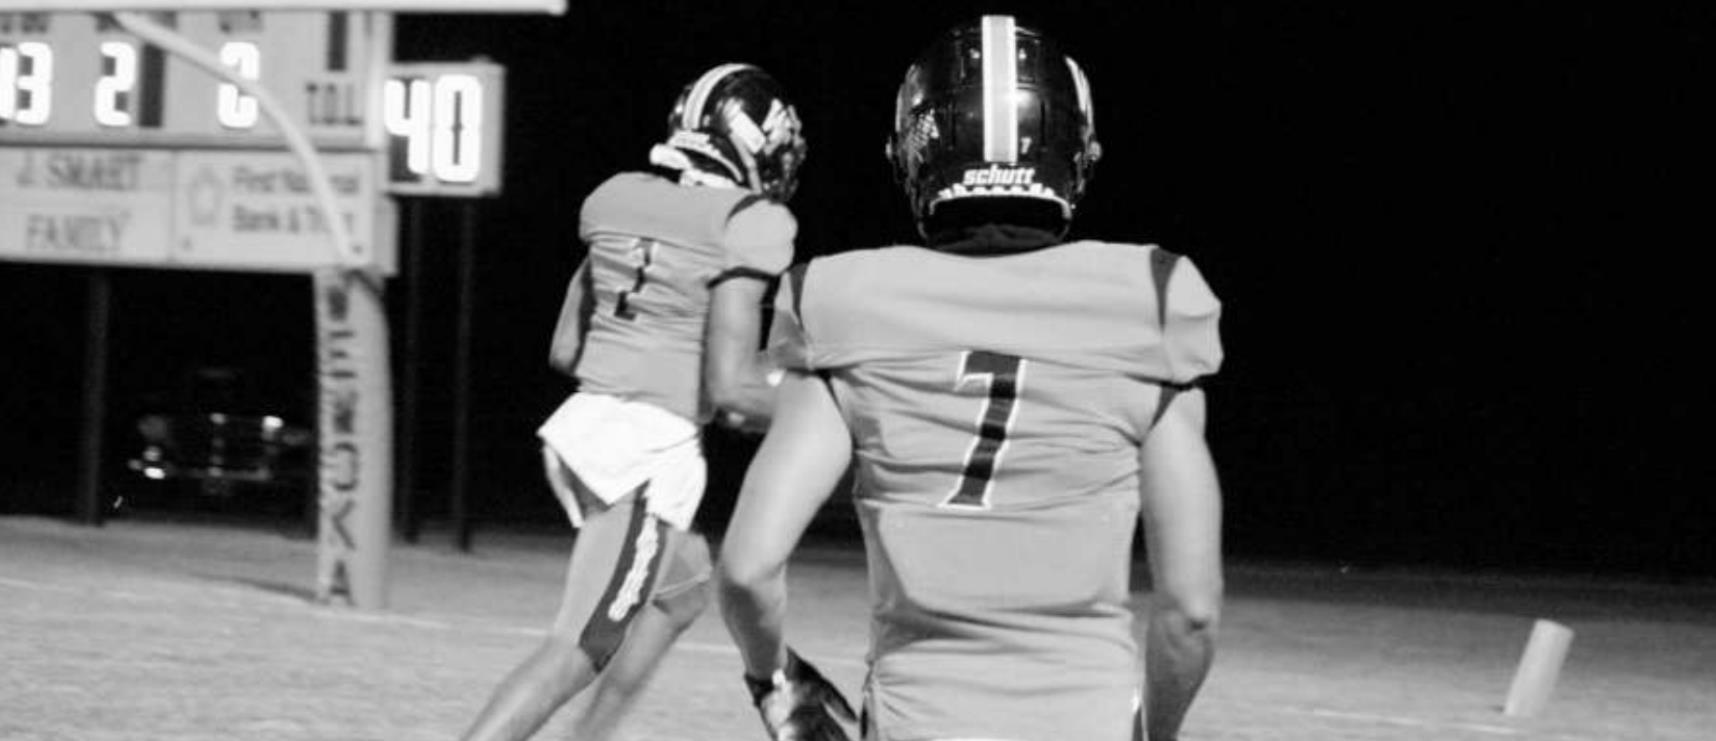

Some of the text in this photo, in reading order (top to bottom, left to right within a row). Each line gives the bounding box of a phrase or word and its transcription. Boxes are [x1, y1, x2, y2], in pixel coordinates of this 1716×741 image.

[94, 42, 137, 126] 2
[384, 74, 483, 182] 40
[1021, 137, 1032, 155] 7
[963, 163, 1036, 185] schutt
[937, 350, 1028, 511] 7
